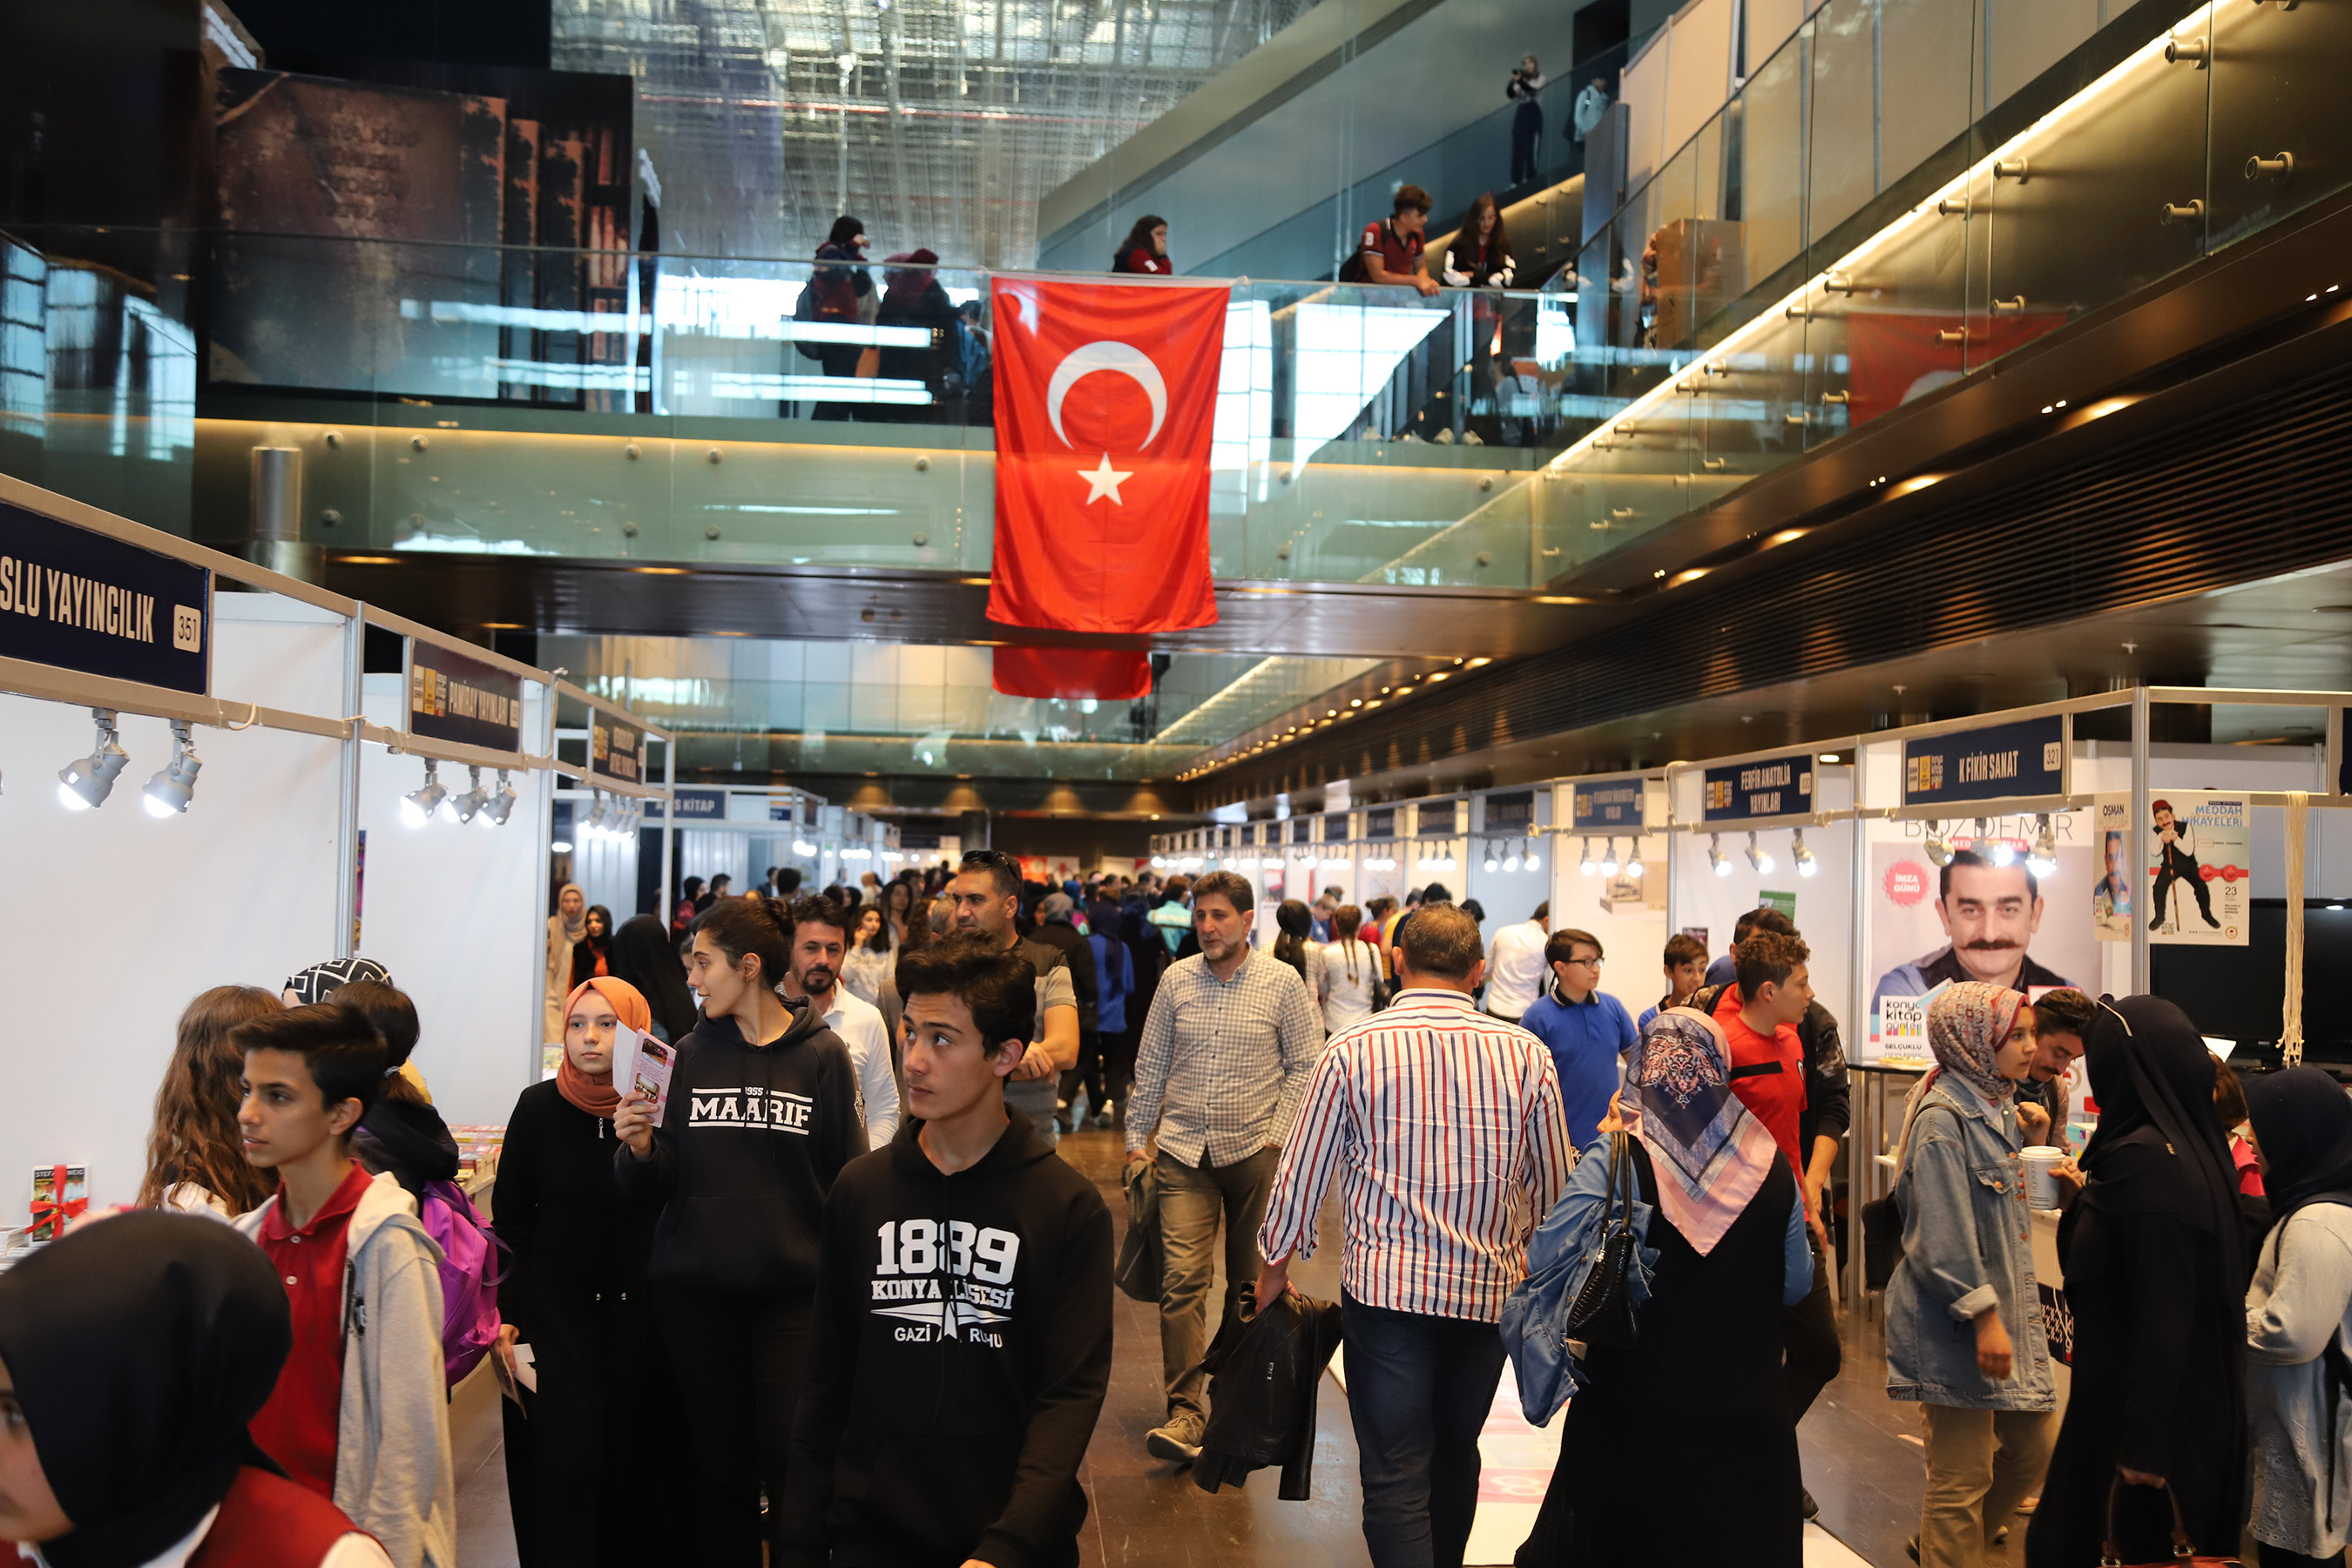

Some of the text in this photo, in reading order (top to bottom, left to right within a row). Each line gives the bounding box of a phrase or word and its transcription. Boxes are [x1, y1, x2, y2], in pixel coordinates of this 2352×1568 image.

[0, 556, 155, 644] SLU YAYINCILIK
[178, 615, 198, 643] 351
[2046, 747, 2059, 765] 321
[1761, 761, 1791, 788] ANATOLİA
[1959, 758, 1966, 783] K
[1966, 750, 1988, 782] FİKİR
[1989, 750, 2019, 781] SANAT
[682, 796, 715, 812] KİTAP
[1750, 791, 1781, 814] YAYINLARI
[2102, 803, 2125, 816] OSMAN
[2195, 805, 2243, 815] MEDDAH
[1895, 872, 1919, 882] İMZA
[1893, 882, 1921, 893] GÜNÜ
[2225, 886, 2238, 896] 23
[1886, 1009, 1922, 1022] kitap
[745, 1086, 764, 1096] 1955
[689, 1097, 813, 1127] MAARIF
[876, 1219, 1021, 1285] 1889
[871, 1278, 1015, 1309] KONYA LİSESİ
[894, 1324, 931, 1342] GAZİ
